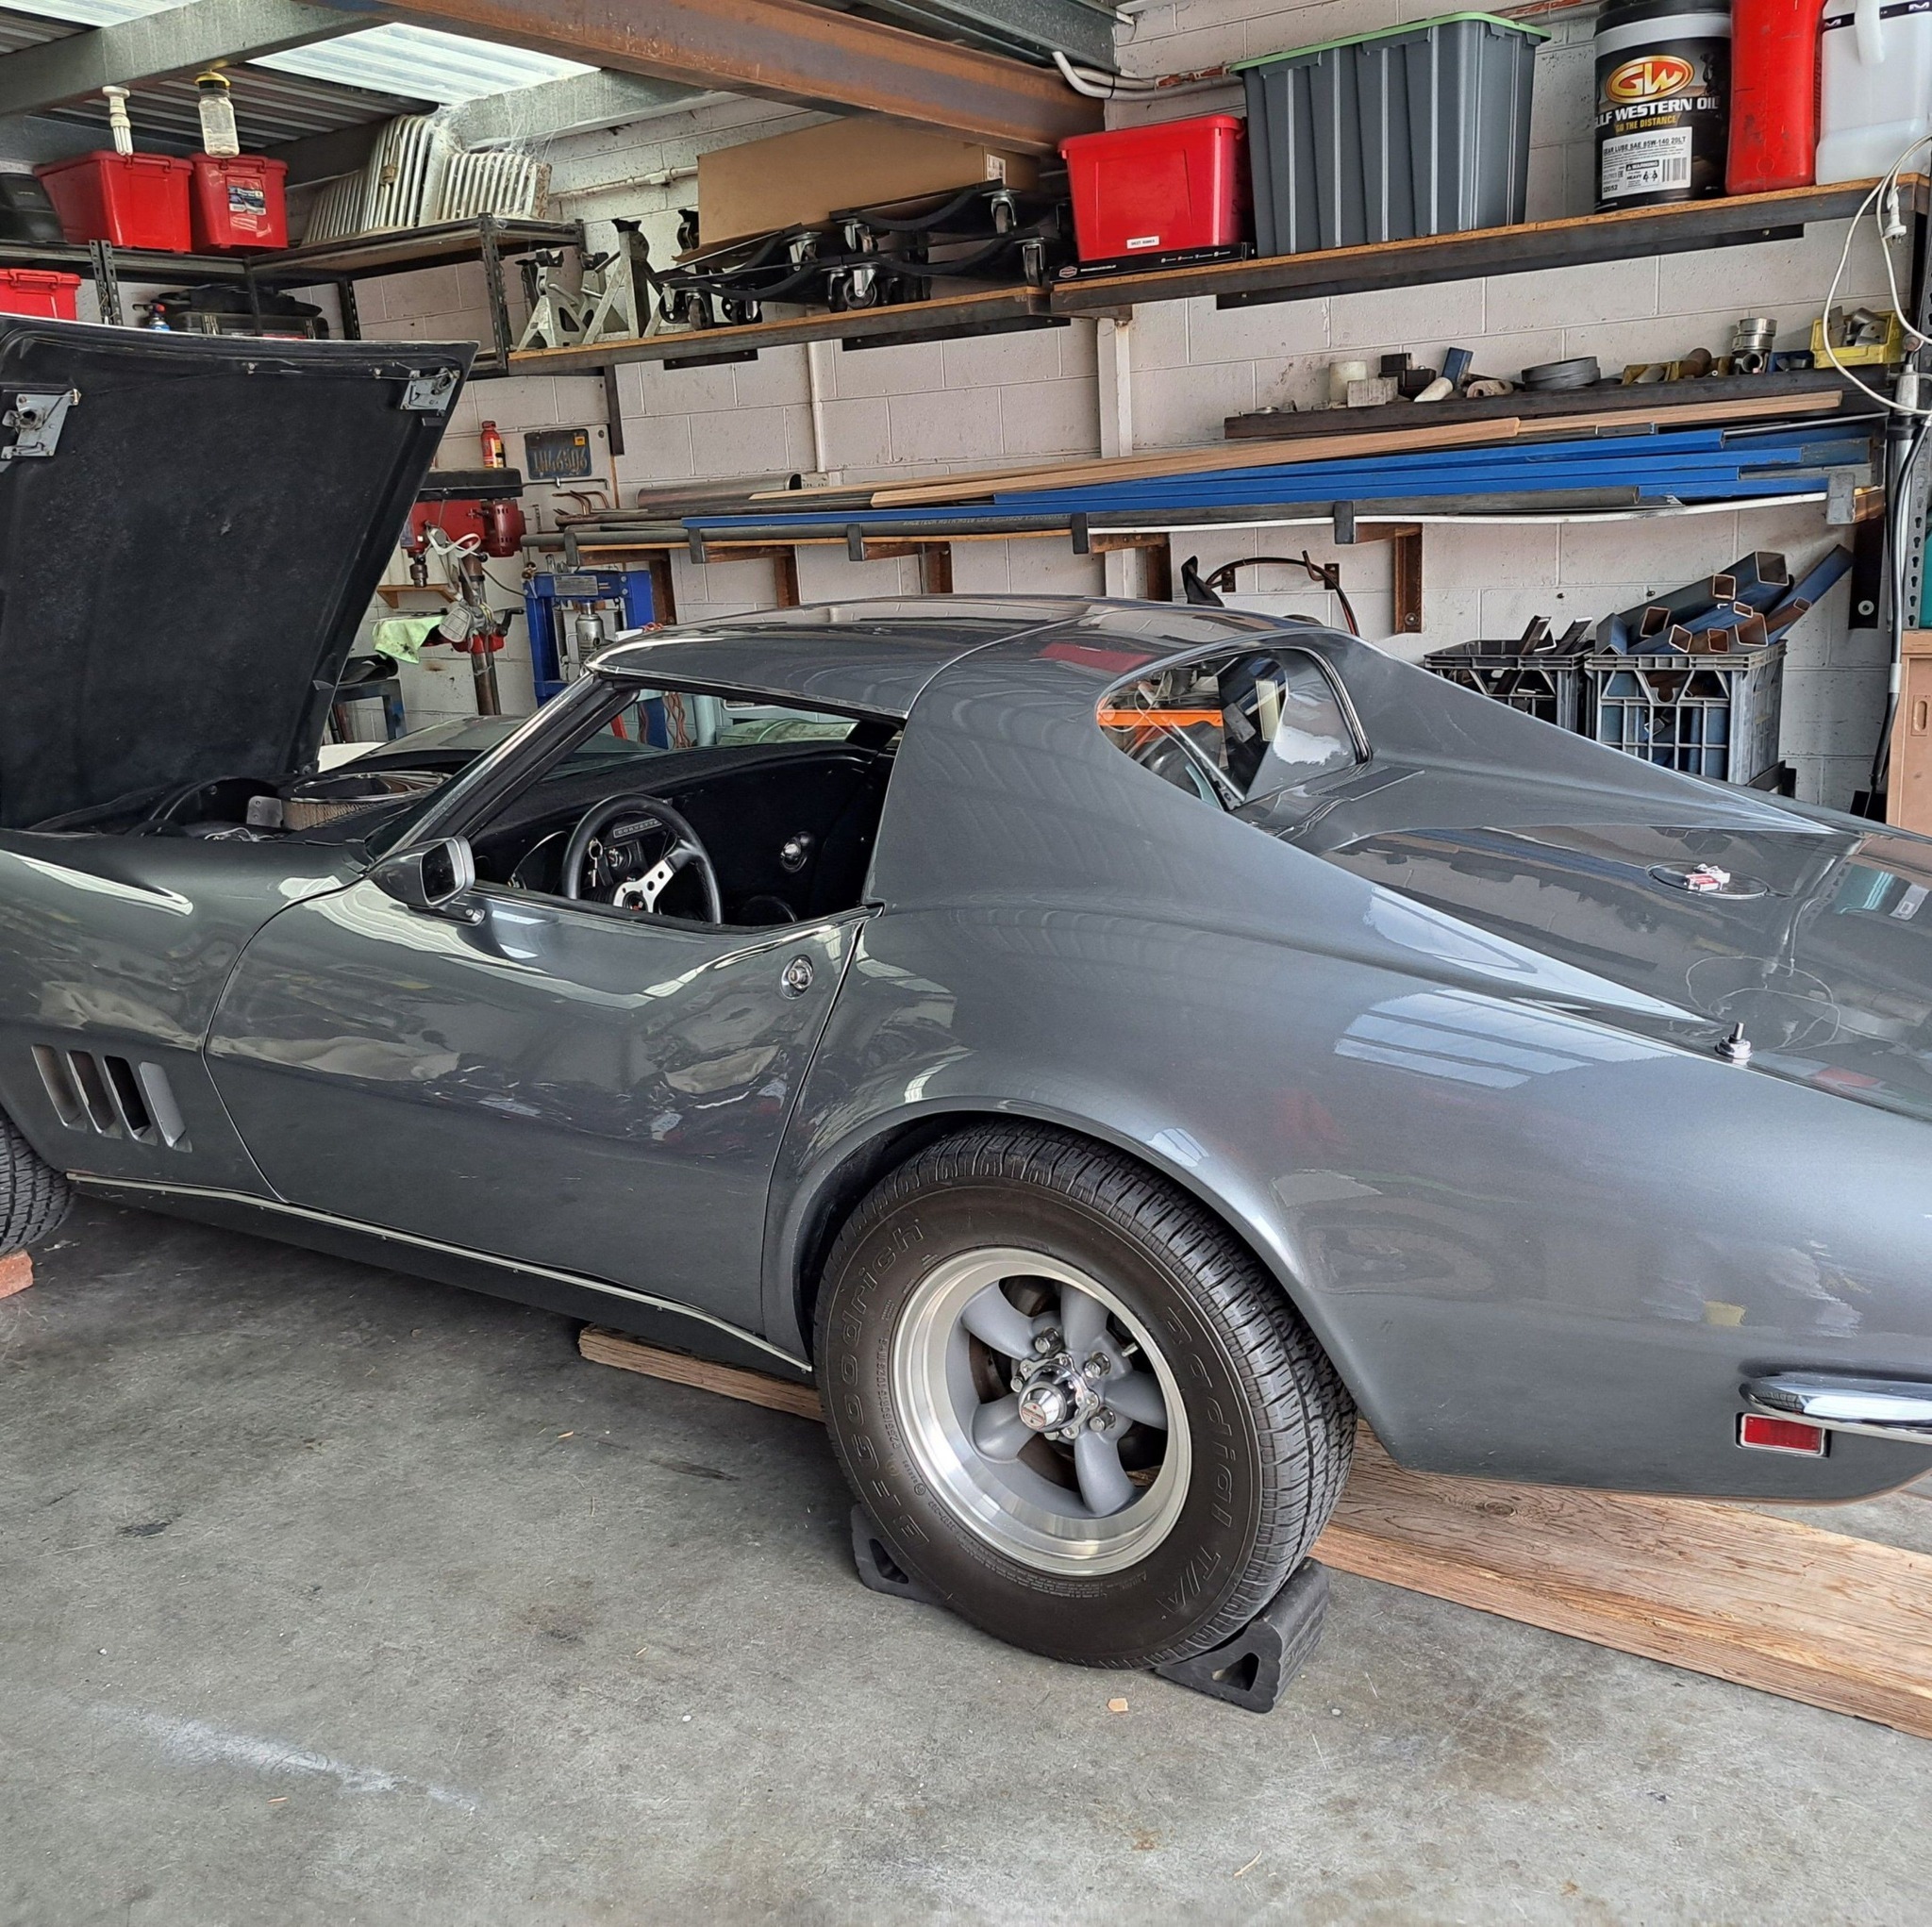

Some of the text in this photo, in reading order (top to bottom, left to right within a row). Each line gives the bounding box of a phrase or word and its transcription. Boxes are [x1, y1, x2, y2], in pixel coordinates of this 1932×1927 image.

[1611, 62, 1683, 96] GW
[1594, 97, 1718, 127] ULF WESTERN OIL
[1616, 115, 1676, 132] GO THE DISTANCE
[1614, 143, 1628, 153] LUBE
[1630, 141, 1641, 150] SAE
[618, 820, 658, 835] CORVETTE
